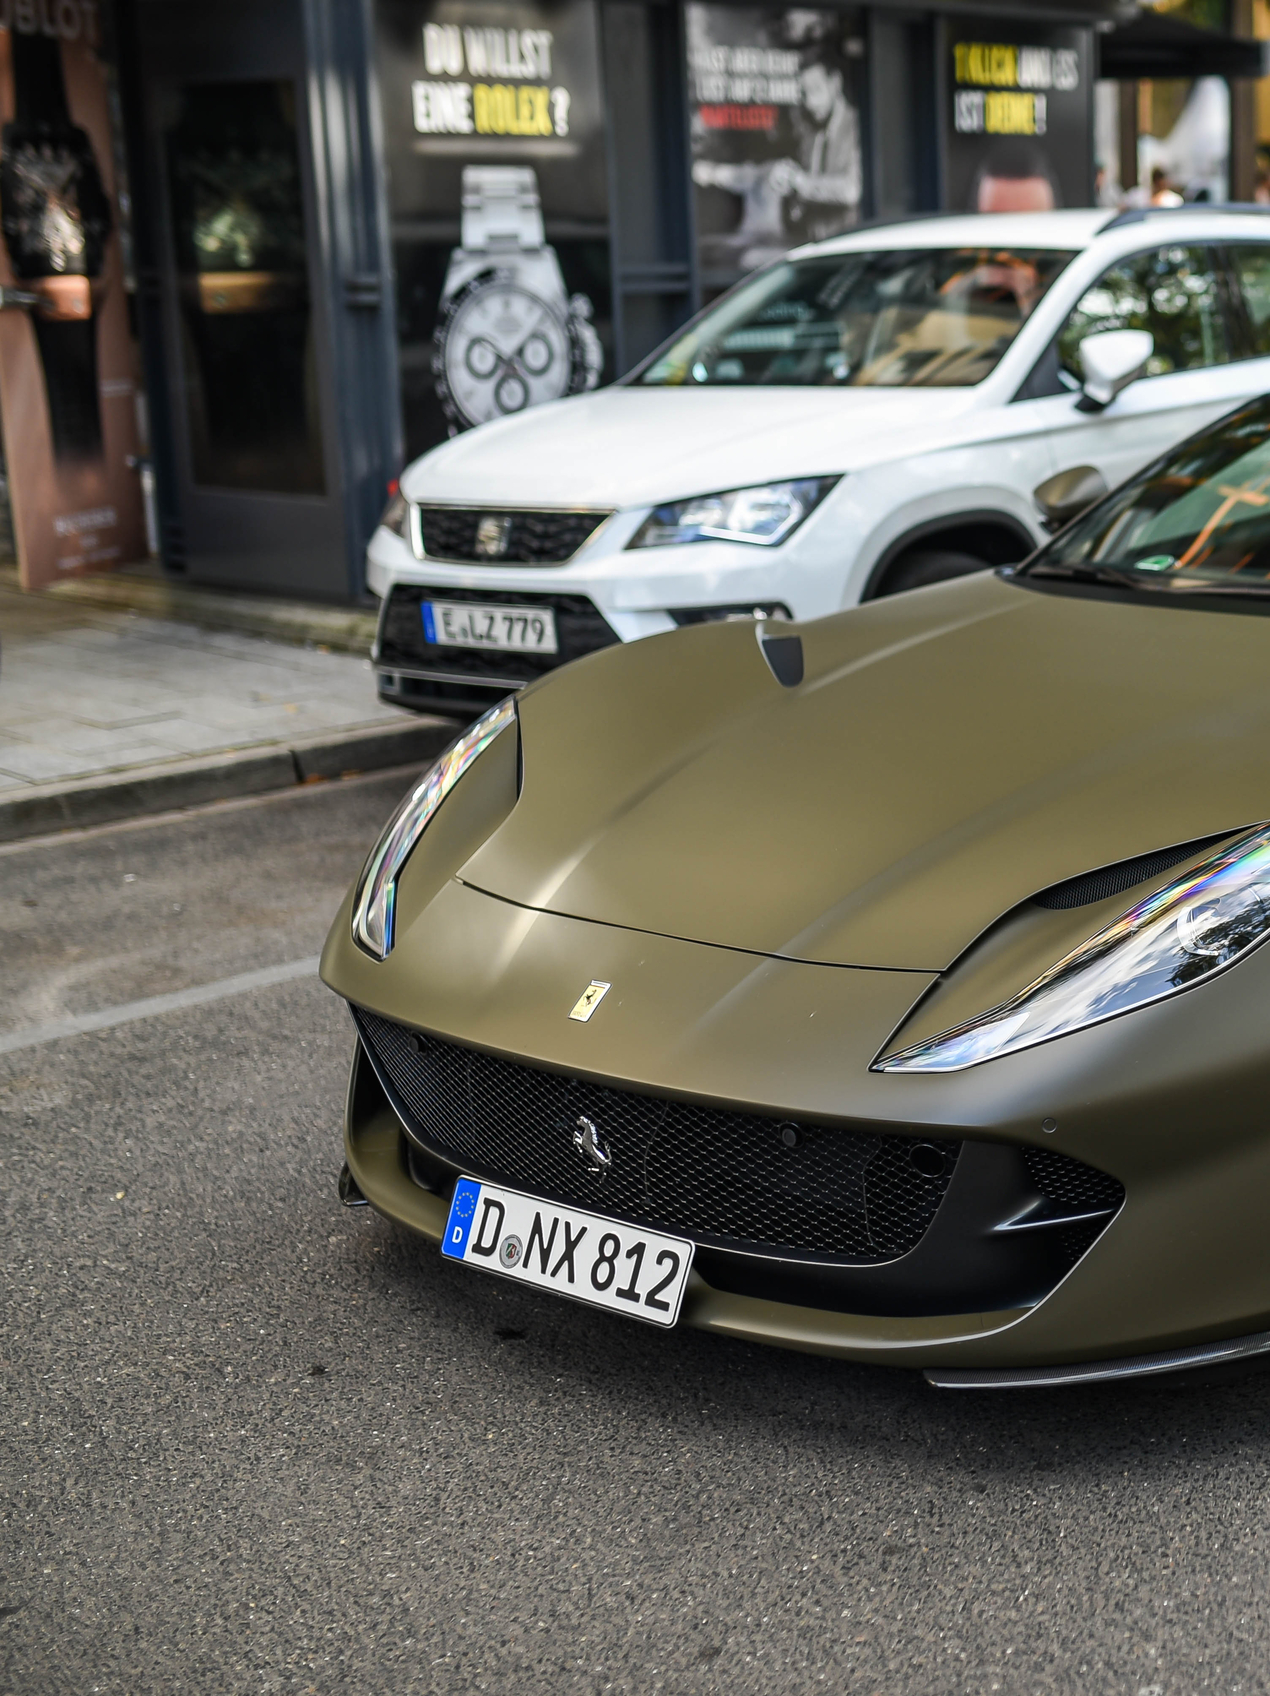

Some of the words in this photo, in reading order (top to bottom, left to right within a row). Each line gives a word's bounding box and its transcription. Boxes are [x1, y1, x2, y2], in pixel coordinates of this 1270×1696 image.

[423, 22, 464, 76] DU
[463, 25, 553, 80] WILLST
[412, 80, 474, 134] EINE
[954, 90, 985, 134] IST
[442, 609, 456, 639] E
[468, 612, 498, 642] LZ
[502, 615, 545, 645] 779
[452, 1226, 463, 1243] D
[471, 1197, 505, 1256] D
[522, 1211, 588, 1284] NX
[590, 1232, 680, 1312] 812
